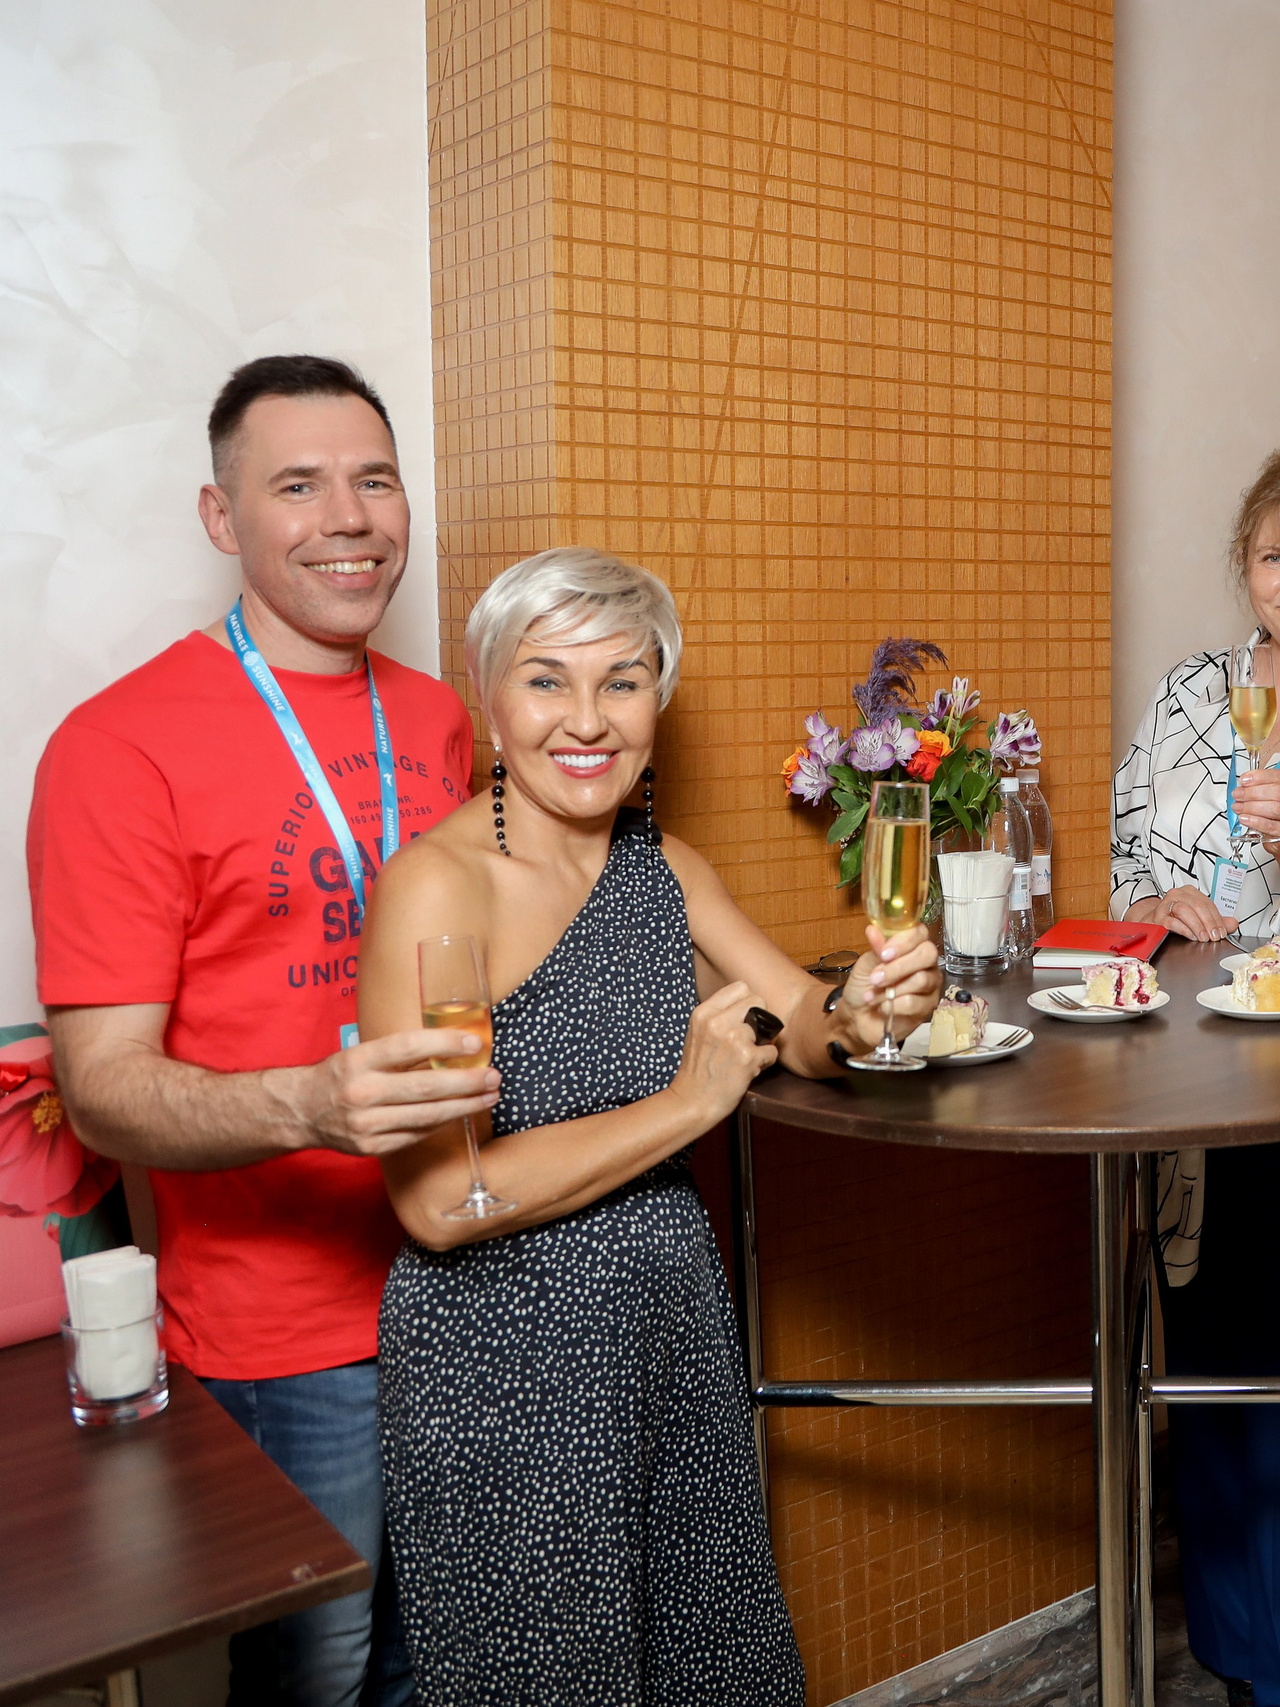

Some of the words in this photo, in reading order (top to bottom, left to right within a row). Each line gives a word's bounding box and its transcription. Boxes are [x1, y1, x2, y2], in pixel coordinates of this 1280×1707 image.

[252, 665, 286, 712] SUNSHINE
[268, 781, 314, 917] SUPERIO
[328, 751, 429, 778] VINTGE
